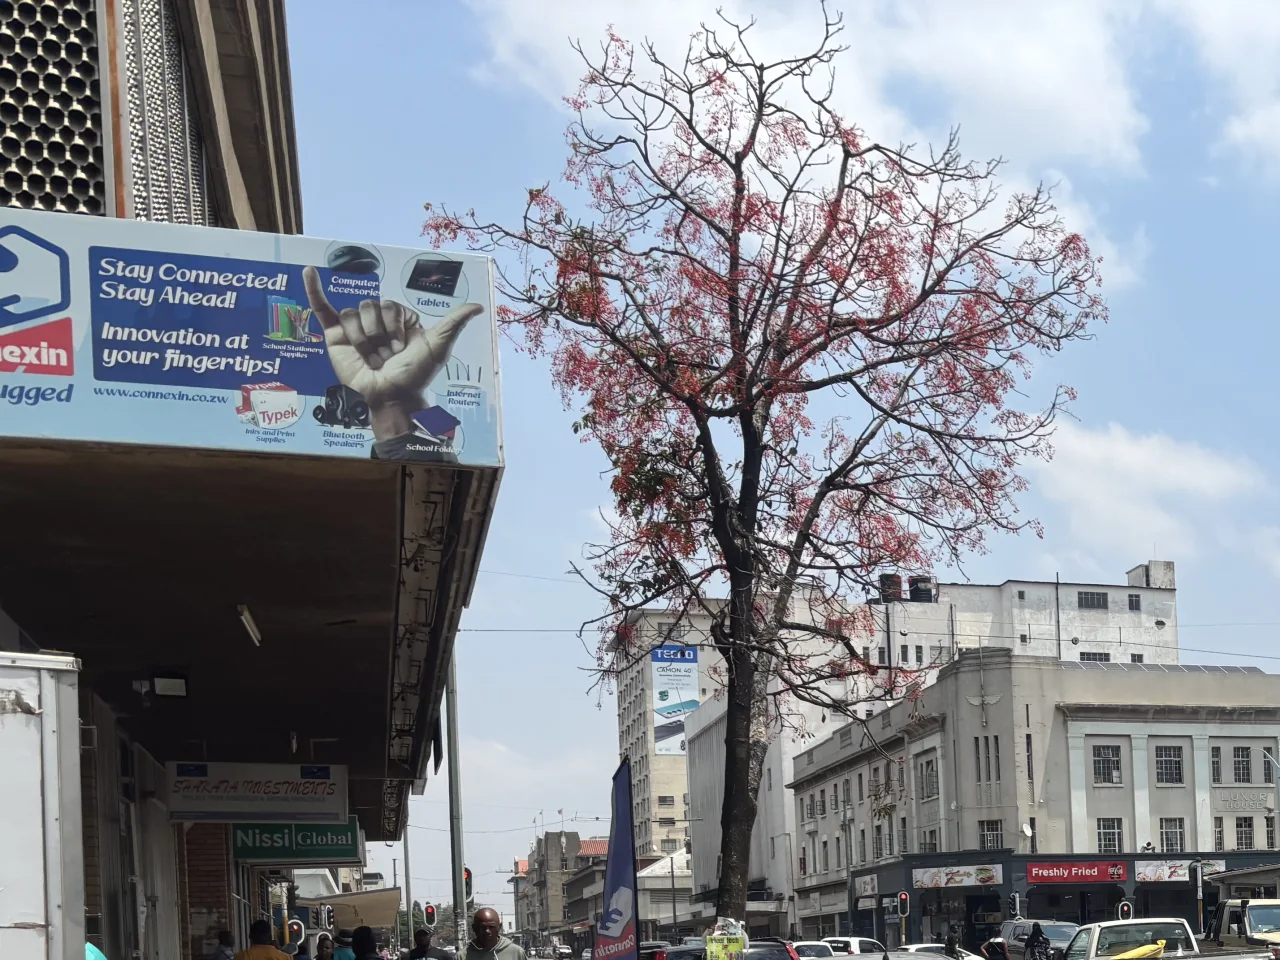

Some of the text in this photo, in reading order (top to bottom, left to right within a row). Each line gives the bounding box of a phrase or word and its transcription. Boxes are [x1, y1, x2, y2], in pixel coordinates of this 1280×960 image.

[98, 258, 288, 291] Stay Connected!
[331, 276, 379, 291] Computer
[99, 281, 238, 309] Stay Ahead!
[328, 285, 382, 298] Accessories
[416, 297, 451, 309] Tablets
[101, 322, 250, 350] Innovation at
[0, 342, 68, 367] exin
[262, 343, 324, 355] School Stationery
[280, 350, 308, 359] Supplies
[102, 348, 281, 377] your fingertips!
[93, 387, 229, 404] www.connexin.co.zw
[447, 390, 482, 399] Internet
[448, 398, 481, 407] Routers
[259, 407, 298, 425] Typek
[322, 430, 365, 441] Bluetooth
[324, 439, 365, 449] Speakers
[406, 443, 433, 452] School
[241, 780, 337, 796] INVESTMENTS
[1221, 792, 1267, 801] LUXOR
[1226, 801, 1265, 809] HOUSE
[236, 829, 352, 848] Nissi Global
[1032, 866, 1098, 878] Freshly Fried
